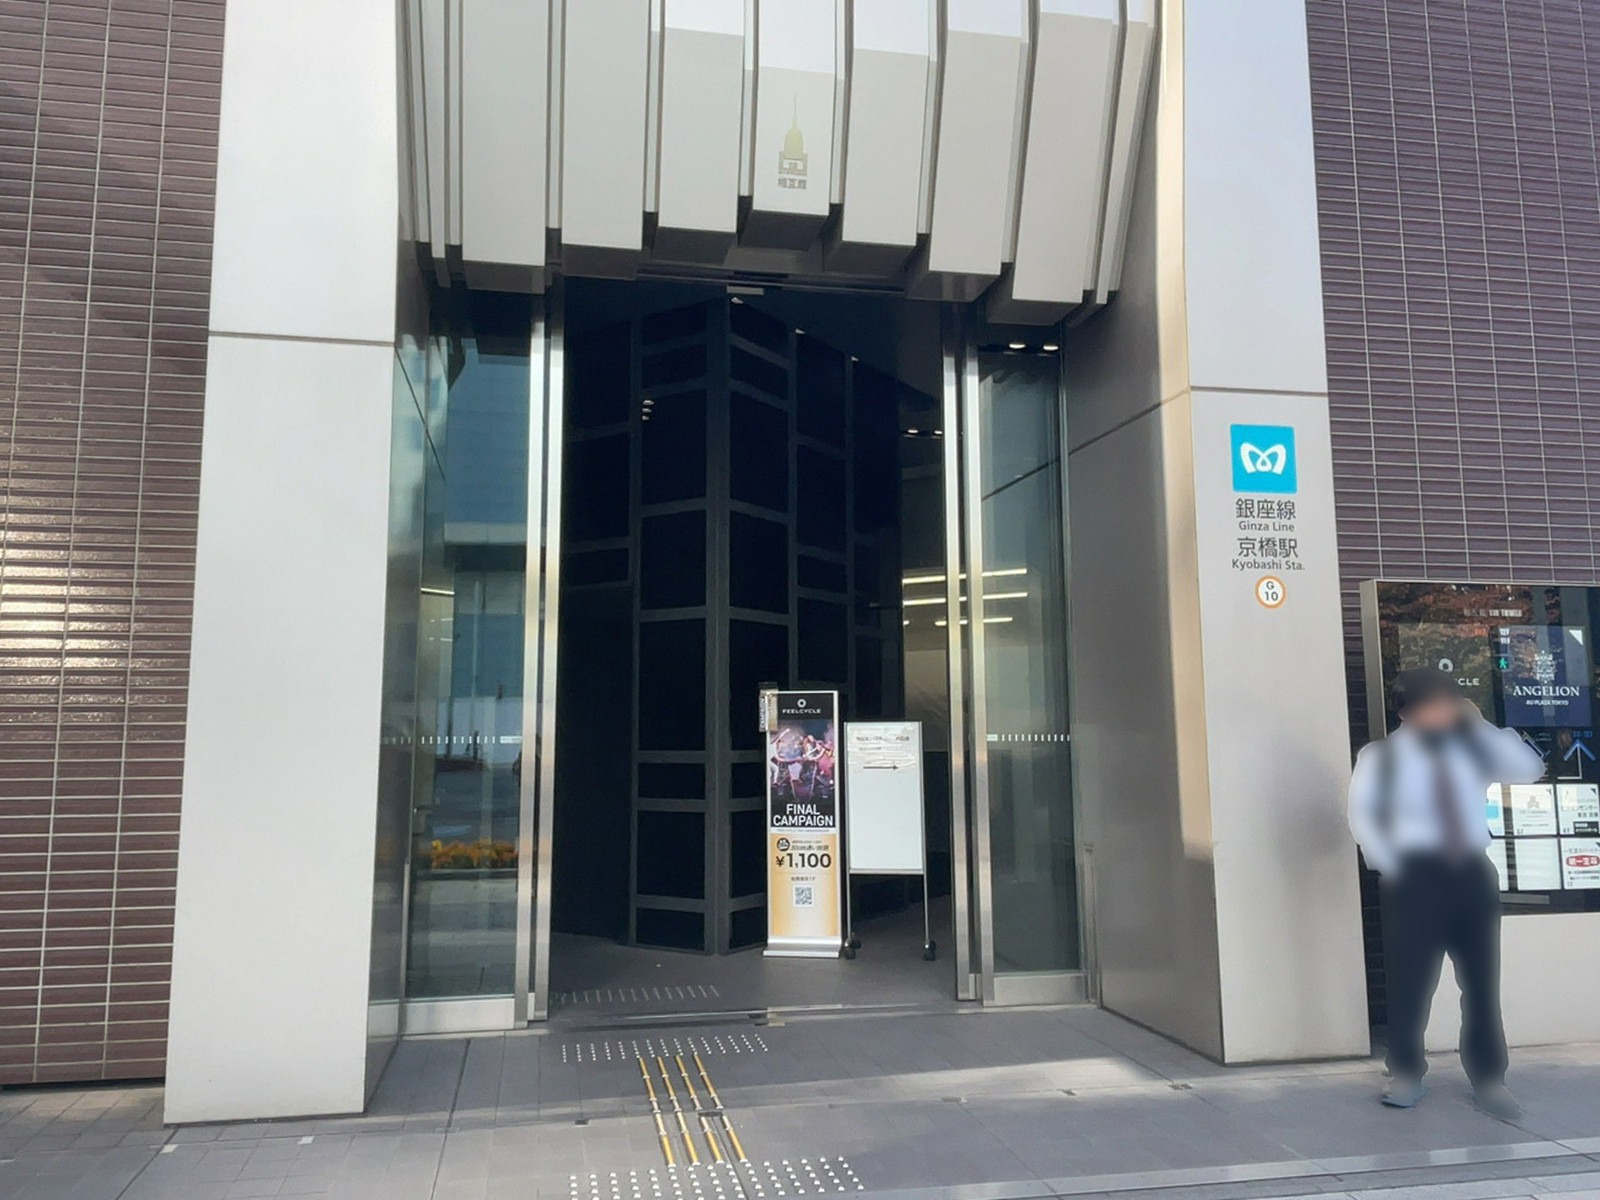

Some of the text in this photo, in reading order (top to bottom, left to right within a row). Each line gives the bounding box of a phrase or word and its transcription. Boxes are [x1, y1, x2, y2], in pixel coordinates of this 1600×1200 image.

[1235, 498, 1297, 520] 銀座線
[1238, 521, 1295, 532] Ginza Line
[1237, 537, 1299, 558] 京橋駅
[1232, 559, 1306, 572] Kyobashi Sta.
[1266, 581, 1275, 590] G
[1264, 591, 1279, 602] 10
[1513, 685, 1580, 697] ANGELION
[786, 803, 820, 815] FINAL
[773, 814, 833, 826] CAMPAIGN
[775, 853, 832, 868] ¥1,100
